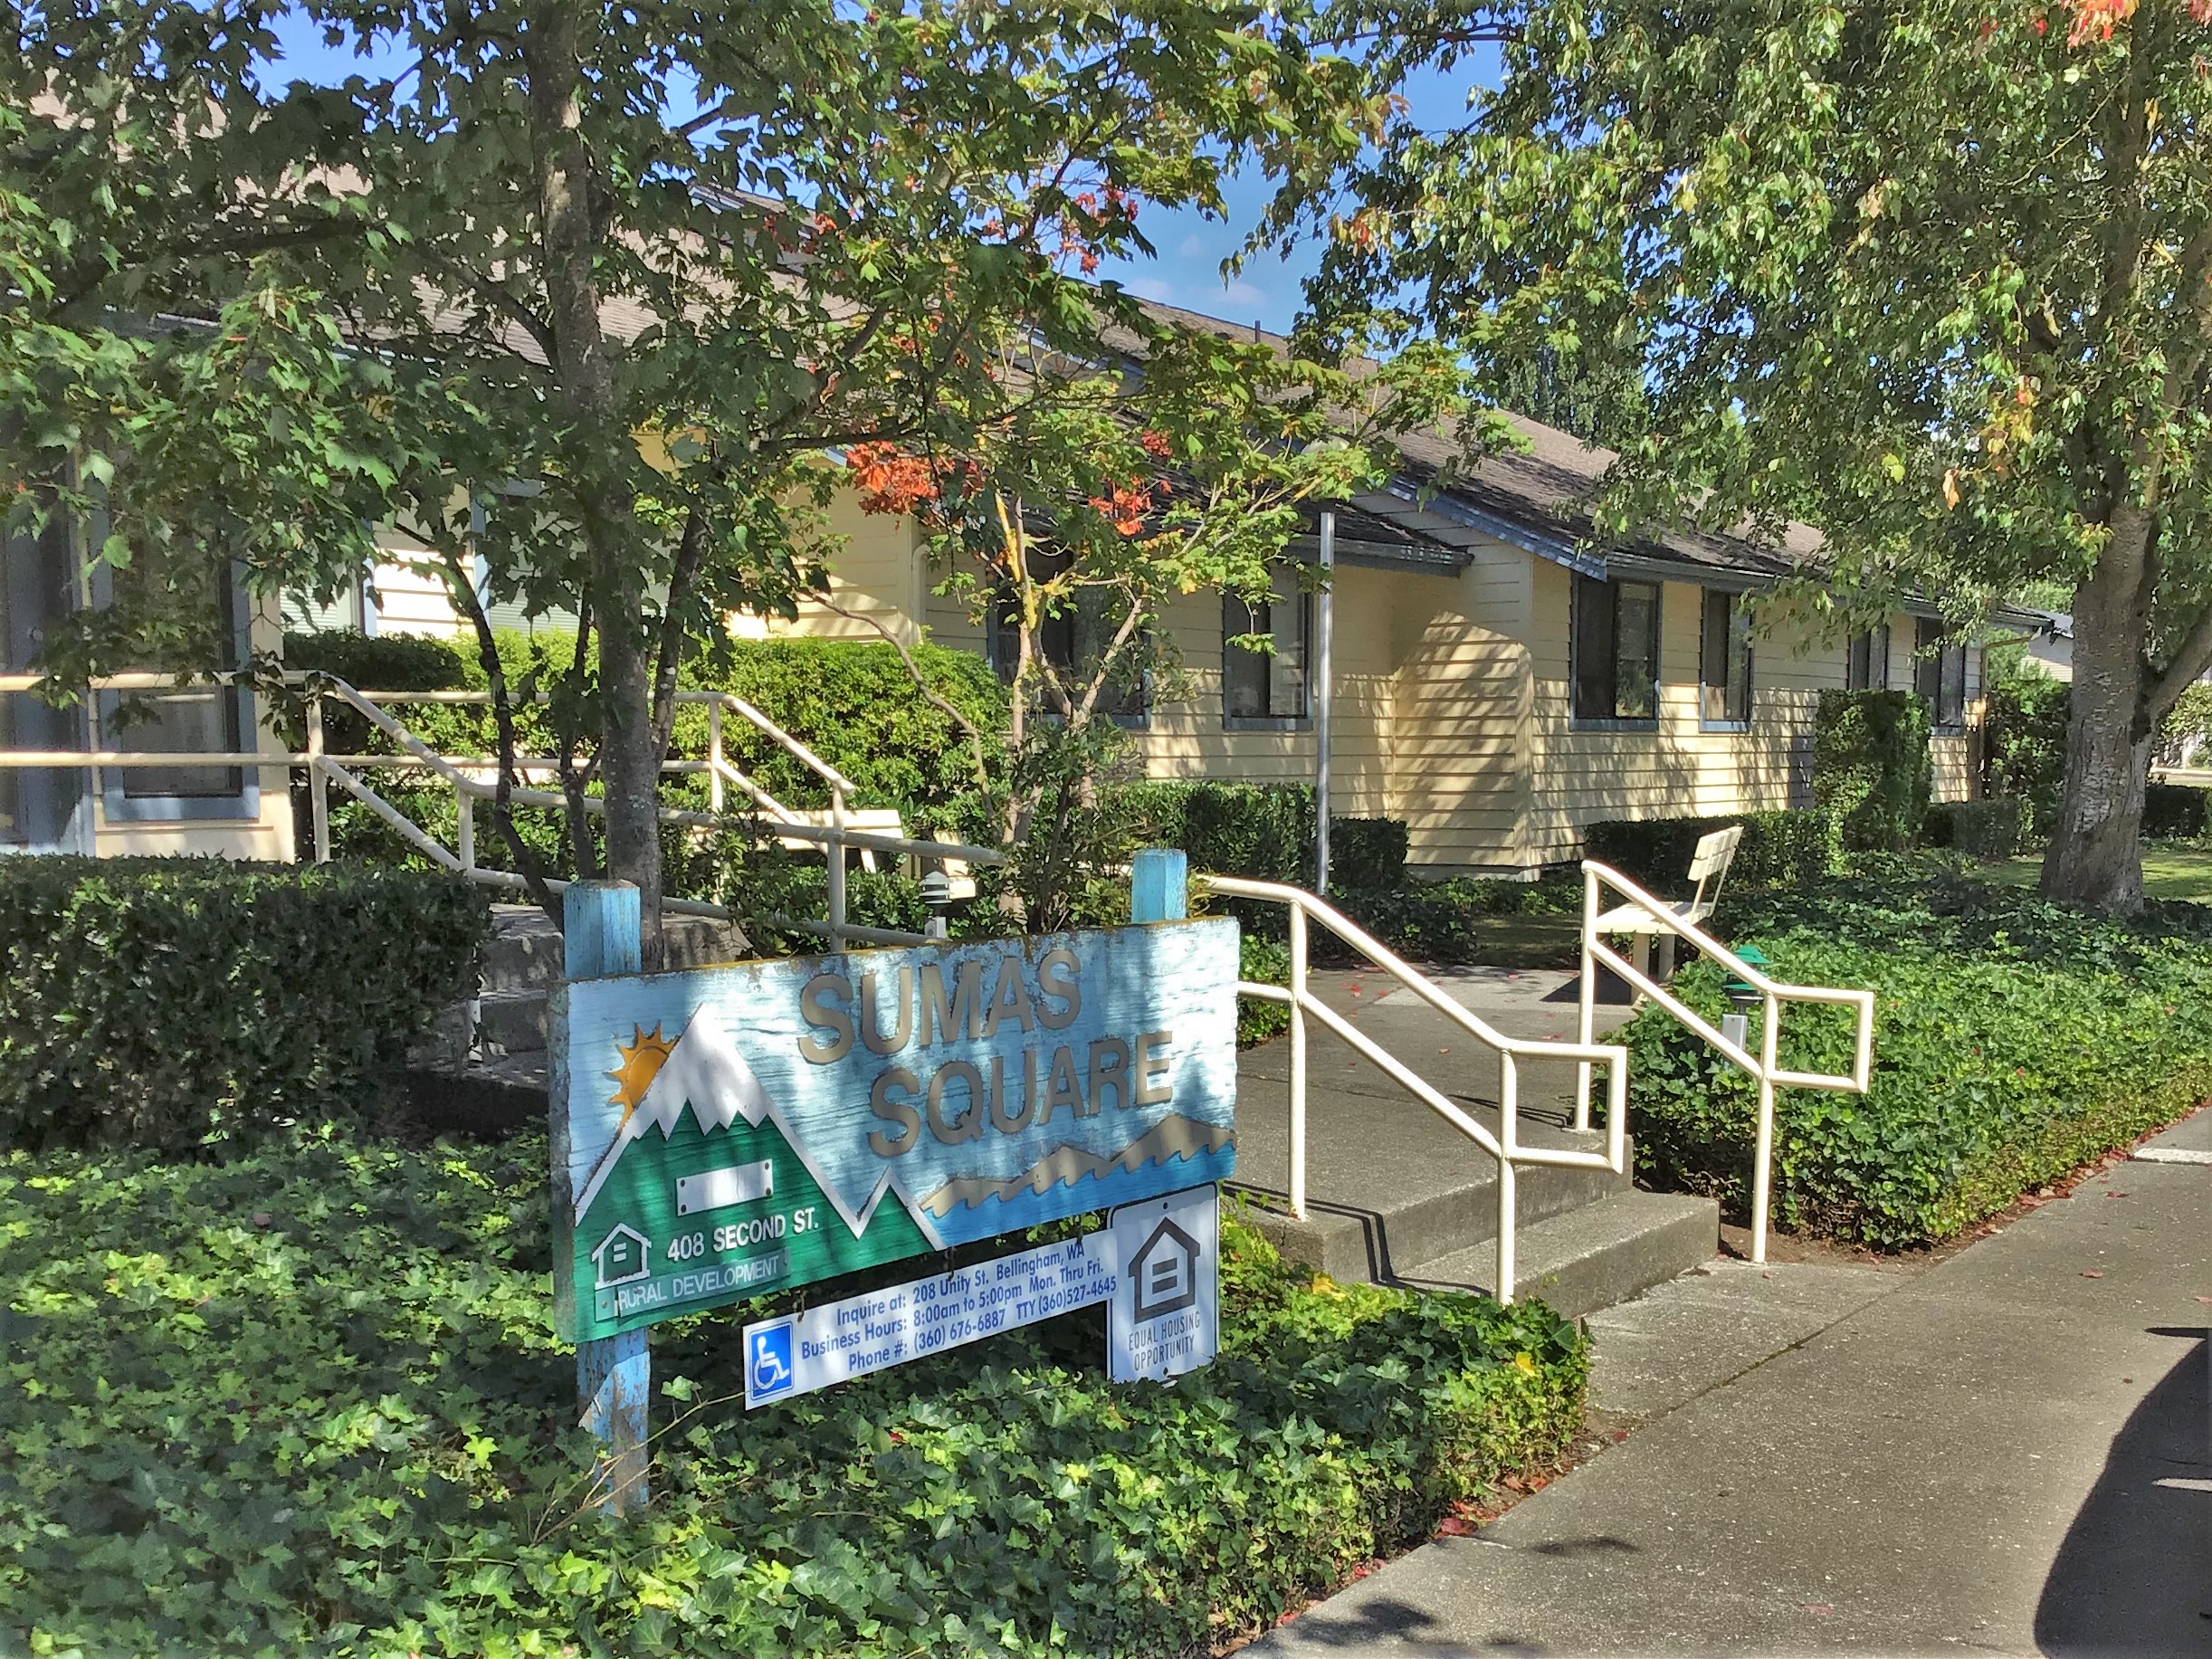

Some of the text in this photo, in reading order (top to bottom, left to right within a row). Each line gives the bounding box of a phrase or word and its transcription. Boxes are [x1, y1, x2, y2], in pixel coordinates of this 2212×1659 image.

[796, 950, 1082, 1064] SUMAS
[867, 1030, 1174, 1158] SQUARE
[667, 1206, 819, 1262] 408 SECOND ST.
[618, 1254, 780, 1311] RURAL DEVELOPMENT
[802, 1257, 1103, 1359] Business Hours: 8:00am to 5:00pm Mon. Thru Fri.
[837, 1243, 1084, 1326] Inquire at: 208 Unity St. Bellingham, WA
[849, 1349, 889, 1371] Phone
[894, 1341, 908, 1358] #:
[914, 1327, 945, 1353] (360)
[950, 1309, 1006, 1340] 676-6887
[1016, 1300, 1035, 1321] TTY
[1129, 1311, 1200, 1351] EQUAL HOUSING
[1134, 1335, 1195, 1371] OPPORTUNITY
